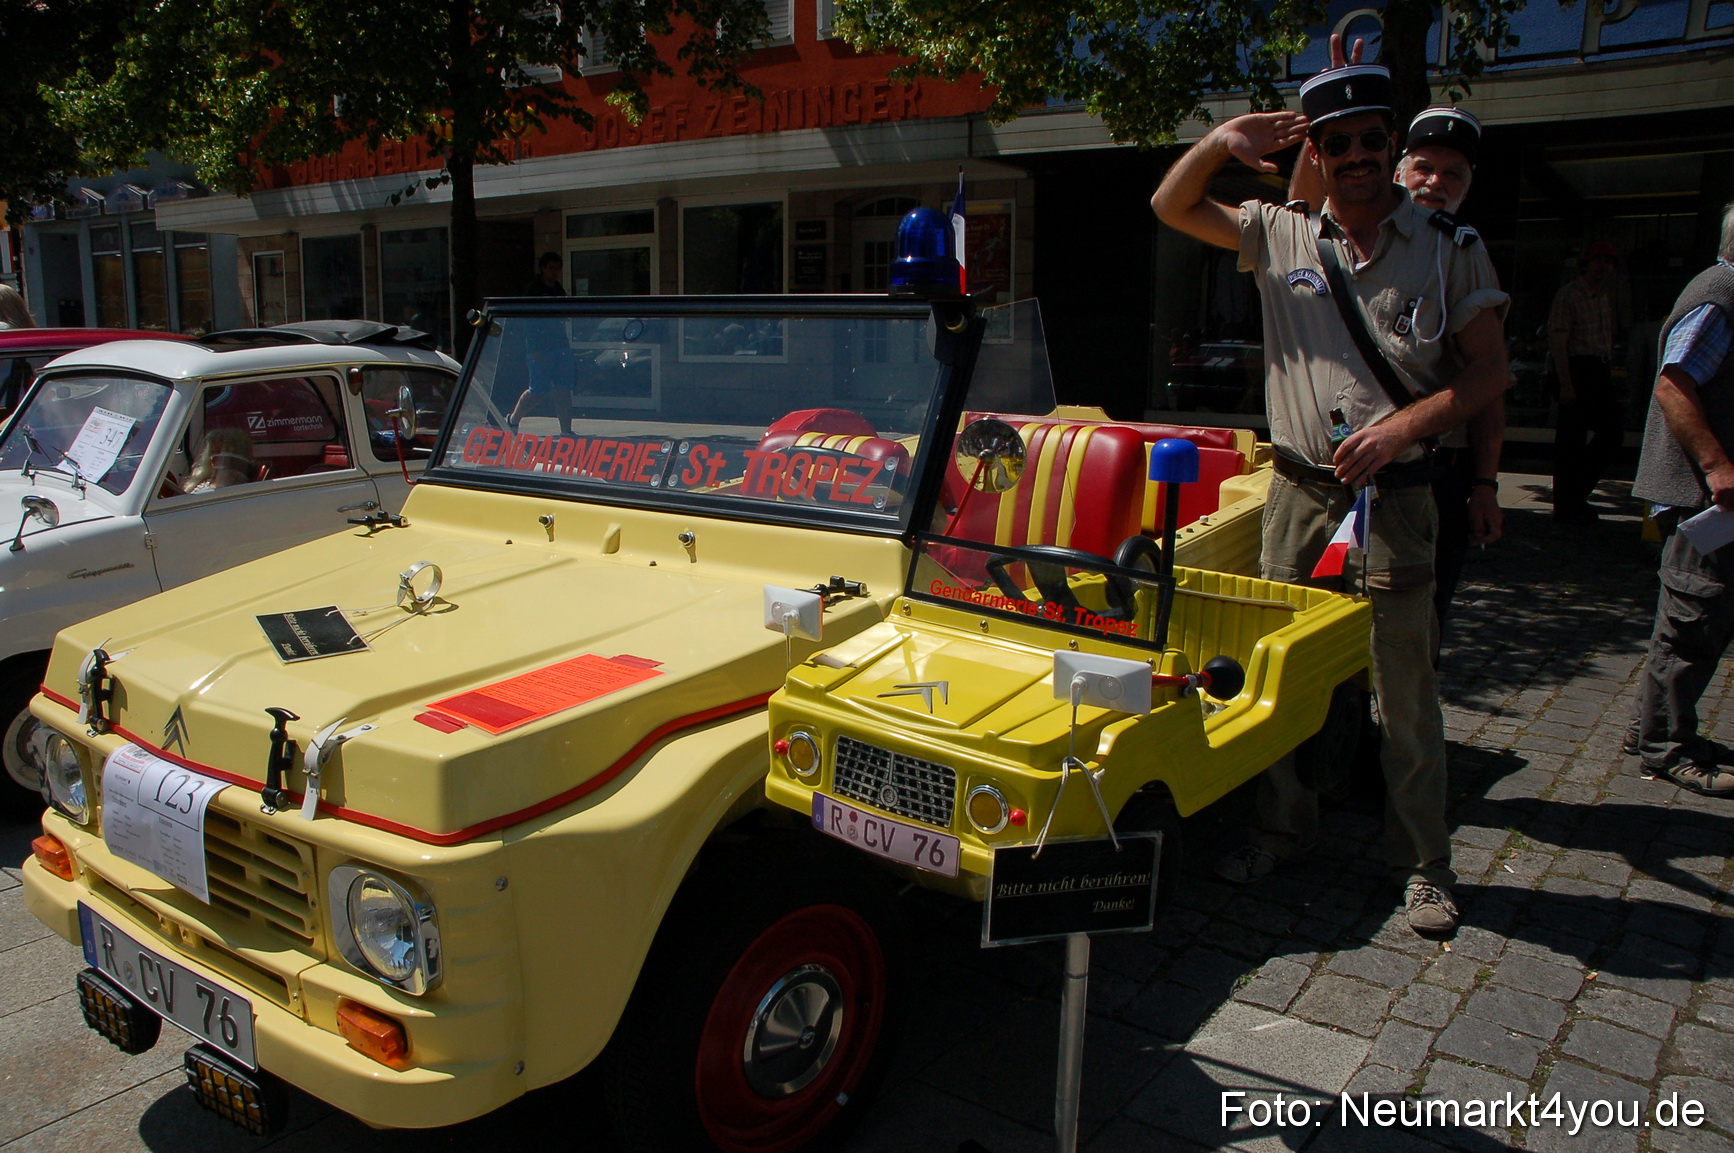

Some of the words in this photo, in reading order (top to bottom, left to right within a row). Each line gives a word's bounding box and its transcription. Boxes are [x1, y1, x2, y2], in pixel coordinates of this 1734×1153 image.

[583, 103, 689, 151] JOSEF
[705, 79, 923, 138] ZEININGER
[266, 415, 322, 427] zimmermann
[463, 427, 662, 483] GENDARMERIE
[681, 445, 726, 488] St.
[741, 450, 885, 504] TROPEZ
[930, 579, 1039, 616] Gendarmerie
[1042, 601, 1067, 622] St.
[1073, 606, 1139, 637] Tropez
[153, 769, 205, 815] 123
[831, 805, 843, 834] R
[864, 819, 895, 853] CV
[913, 833, 945, 867] 76
[996, 882, 1033, 897] Bitte
[1038, 875, 1076, 893] nicht
[1080, 871, 1152, 889] berühren!
[1093, 897, 1135, 911] Danke!
[100, 922, 120, 978] R
[138, 951, 174, 1014] CV
[195, 981, 239, 1049] 76
